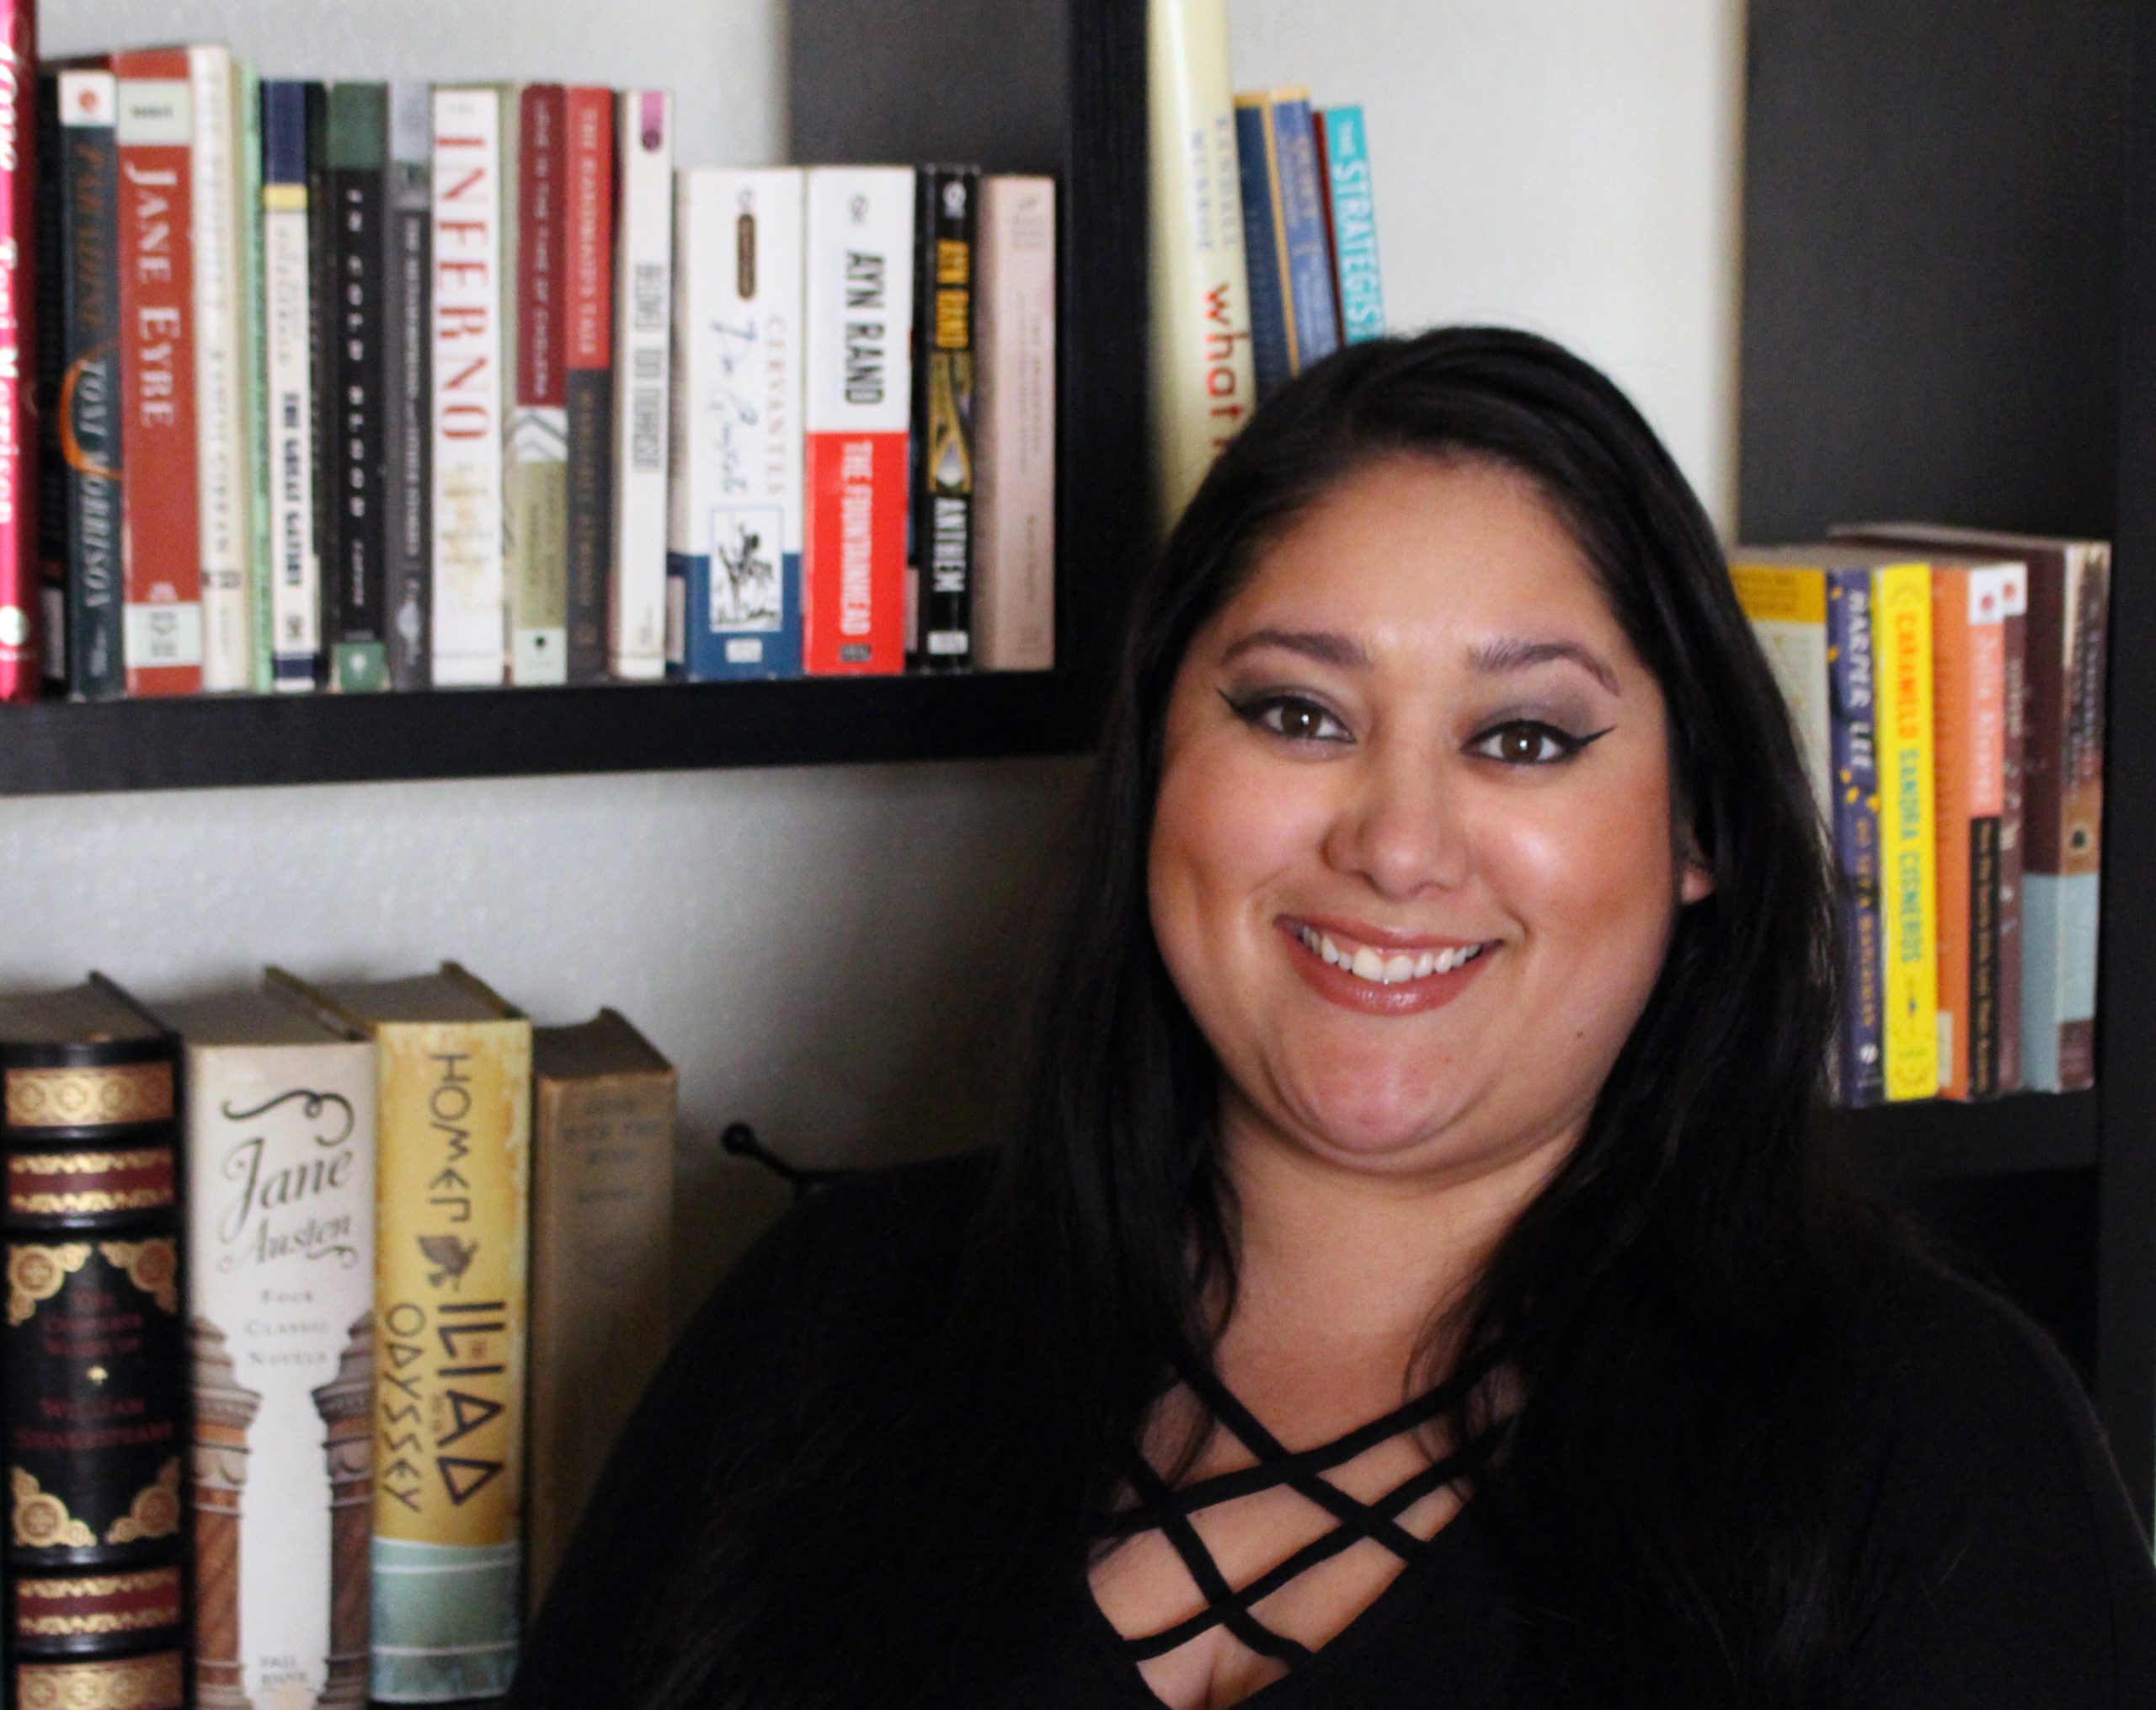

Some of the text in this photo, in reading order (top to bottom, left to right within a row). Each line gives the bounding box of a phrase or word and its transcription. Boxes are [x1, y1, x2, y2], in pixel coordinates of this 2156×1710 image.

[579, 107, 597, 149] THE
[125, 160, 183, 429] JANE EYRE
[346, 254, 366, 362] COLD
[435, 133, 493, 441] INFERNO
[578, 302, 598, 355] TALE
[845, 250, 885, 406] AYN RAND
[80, 357, 110, 440] TONI
[282, 390, 299, 430] THE
[534, 307, 550, 398] CHOLERA
[765, 315, 787, 499] CERVANTES
[1204, 281, 1252, 417] what
[283, 438, 301, 505] GREAT
[346, 384, 367, 519] BLOOD
[841, 440, 873, 482] THE
[79, 450, 115, 611] MORRISON
[283, 511, 302, 588] GATSBY
[840, 484, 873, 636] FOUNTAINHEAD
[932, 497, 968, 593] ANTHEM
[1846, 590, 1874, 768] HARPER LEE
[1895, 612, 1923, 964] CARAMELO SANDRA CISNEROS
[216, 1210, 360, 1274] Austen
[217, 1135, 350, 1244] Jane
[382, 1302, 427, 1513] ODYSSEY
[436, 1300, 505, 1508] ILIAD
